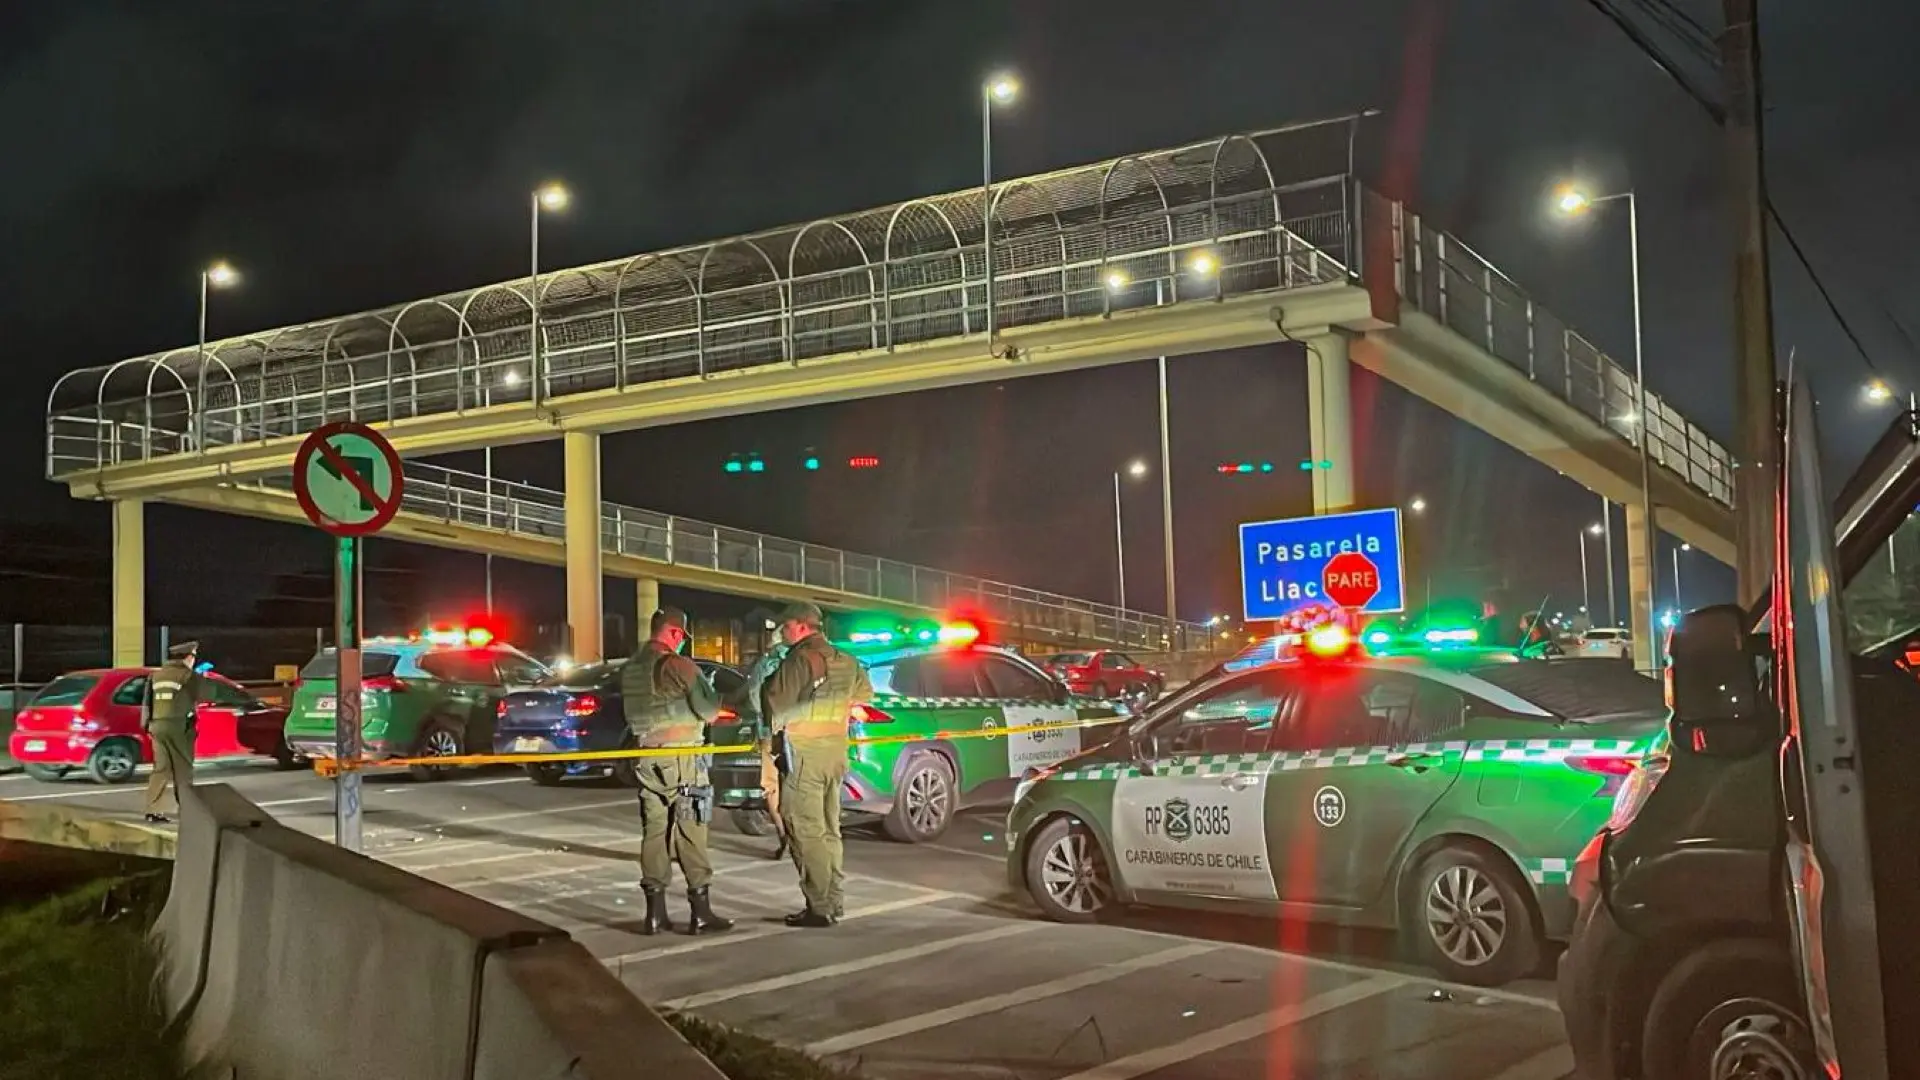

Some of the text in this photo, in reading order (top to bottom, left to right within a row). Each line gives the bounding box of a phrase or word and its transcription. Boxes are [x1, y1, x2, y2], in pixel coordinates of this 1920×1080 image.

[1257, 532, 1380, 564] Pasarela
[1262, 579, 1318, 602] Llac
[1327, 571, 1375, 589] PARE
[1145, 805, 1231, 835] RP 6385
[1320, 804, 1339, 819] 133
[1125, 849, 1262, 870] CARABINEROS DE CHILE
